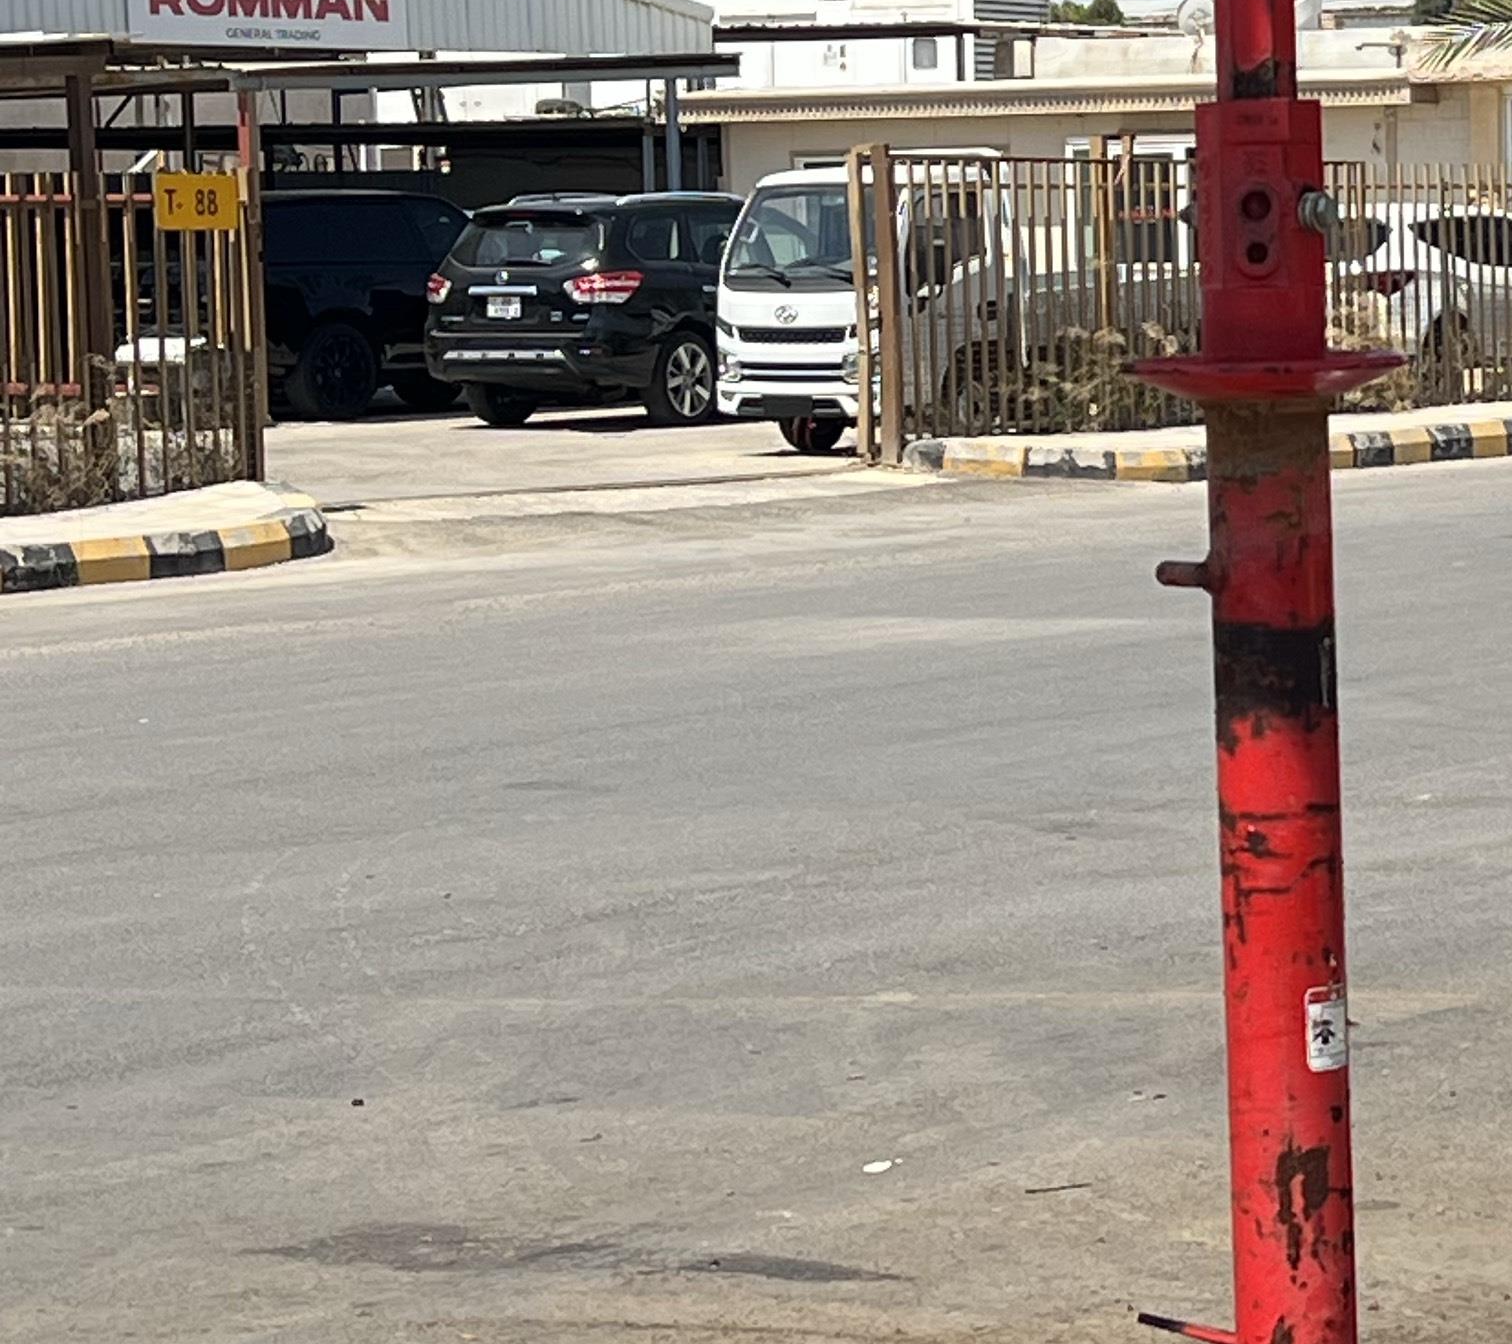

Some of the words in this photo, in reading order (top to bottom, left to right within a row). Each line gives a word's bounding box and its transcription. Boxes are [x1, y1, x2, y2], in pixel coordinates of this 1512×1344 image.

[225, 27, 272, 40] GENERAL
[275, 28, 321, 41] TRADING
[195, 188, 218, 216] 88
